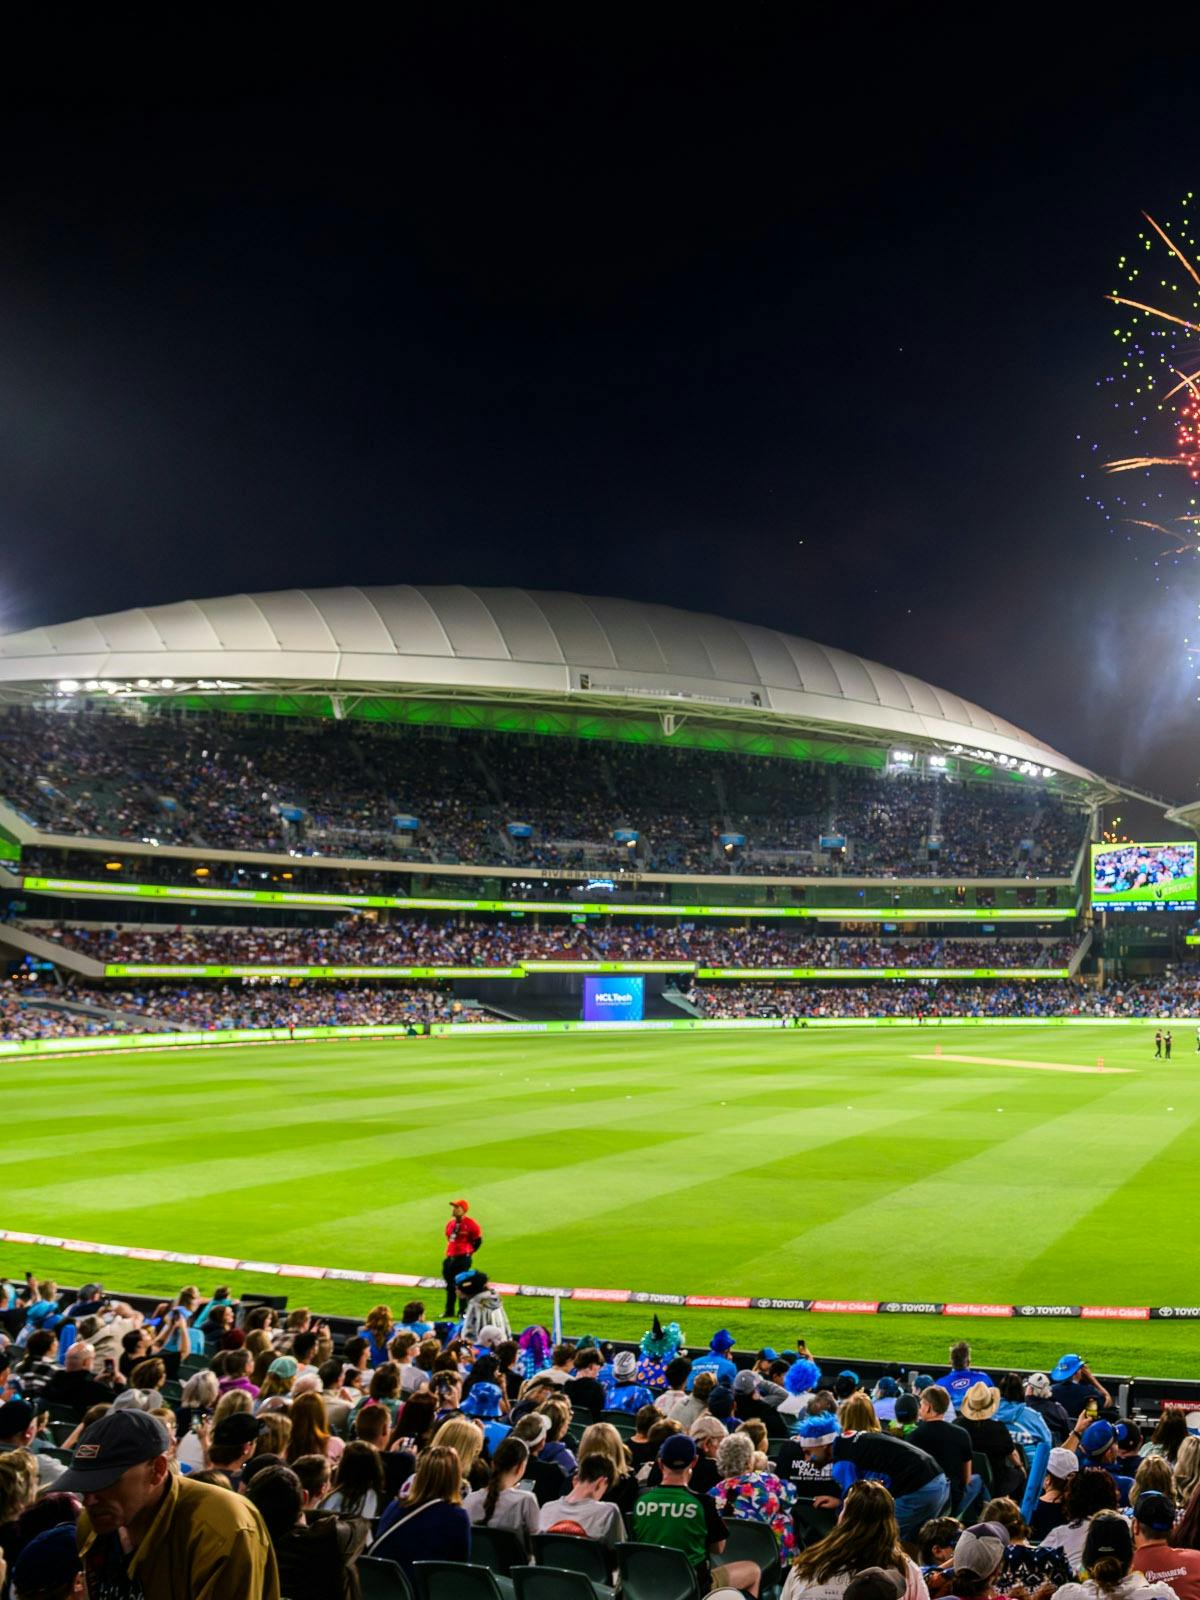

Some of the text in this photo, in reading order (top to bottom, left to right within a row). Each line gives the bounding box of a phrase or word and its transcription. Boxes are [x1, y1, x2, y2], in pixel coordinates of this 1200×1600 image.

[650, 1294, 680, 1303] TOYOTA
[772, 1300, 804, 1309] TOYOTA
[815, 1302, 876, 1311] Good for Cricket
[902, 1304, 936, 1312] TOYOTA
[947, 1304, 1009, 1314] Good for Cricket
[1037, 1306, 1072, 1315] TOYOTA
[1082, 1308, 1147, 1317] Good for Cricket
[798, 1467, 820, 1477] FACE
[635, 1501, 698, 1519] OPTUS
